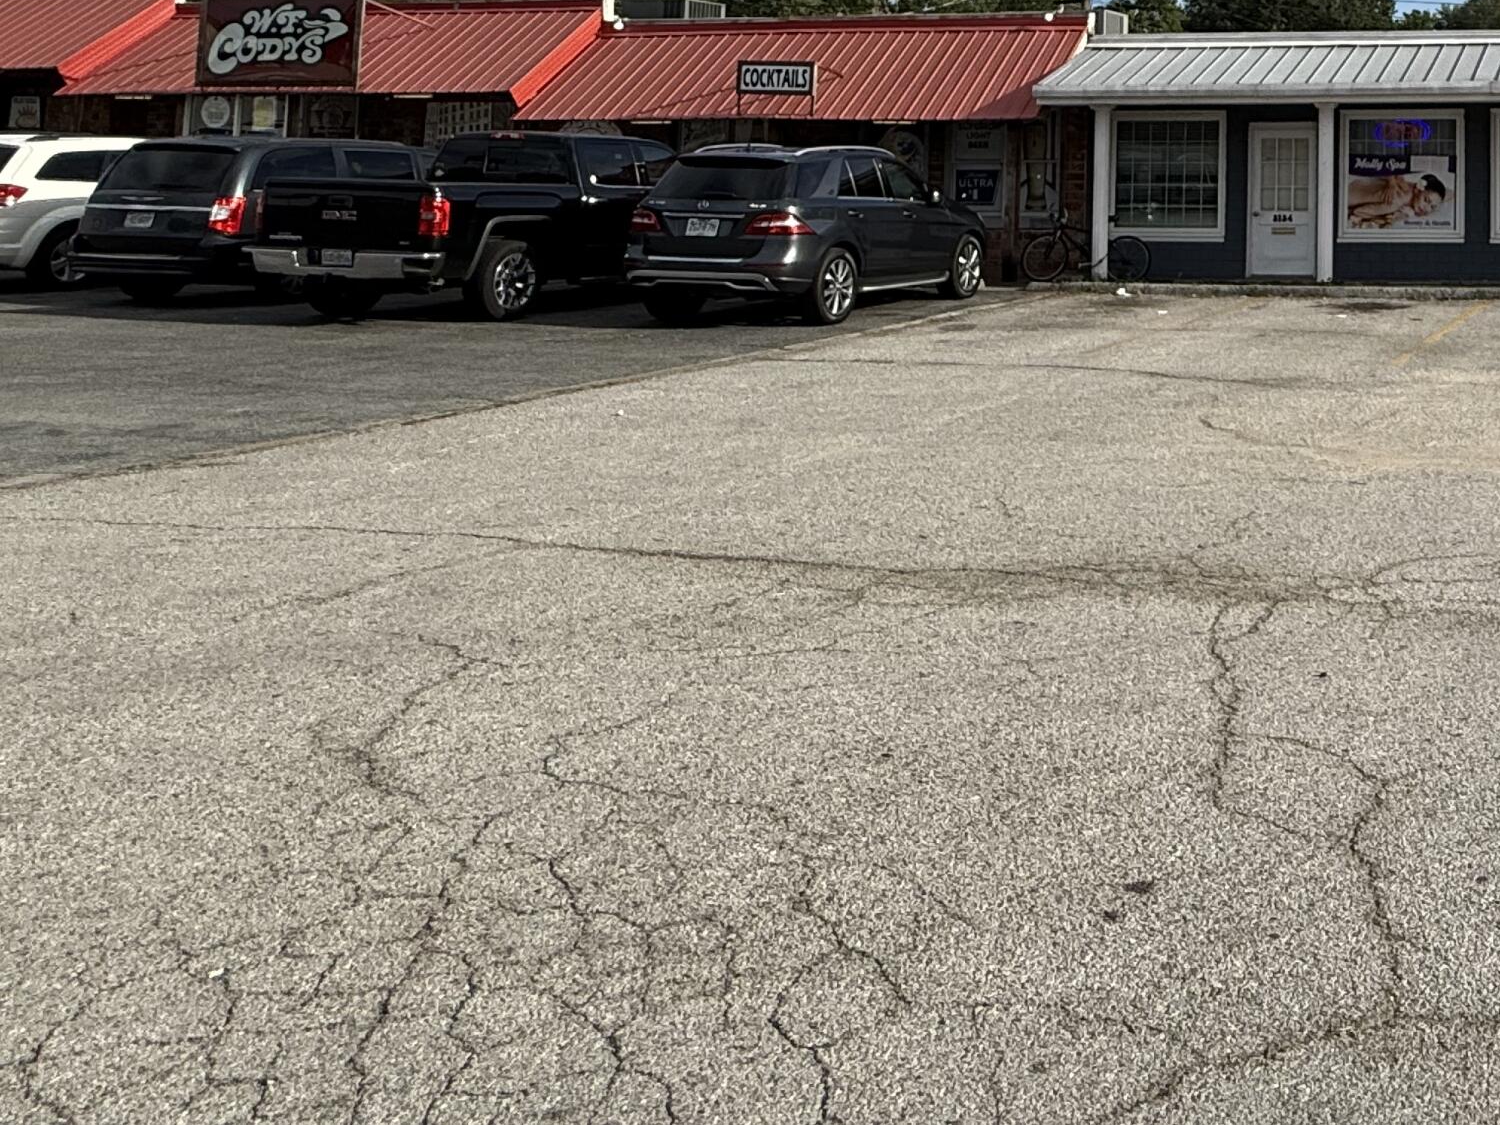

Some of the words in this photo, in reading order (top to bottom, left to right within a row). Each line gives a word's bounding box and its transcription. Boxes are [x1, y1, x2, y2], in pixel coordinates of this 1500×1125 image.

[242, 3, 308, 33] W.F.
[743, 67, 808, 88] COCKTAILS
[958, 178, 994, 188] ULTRA
